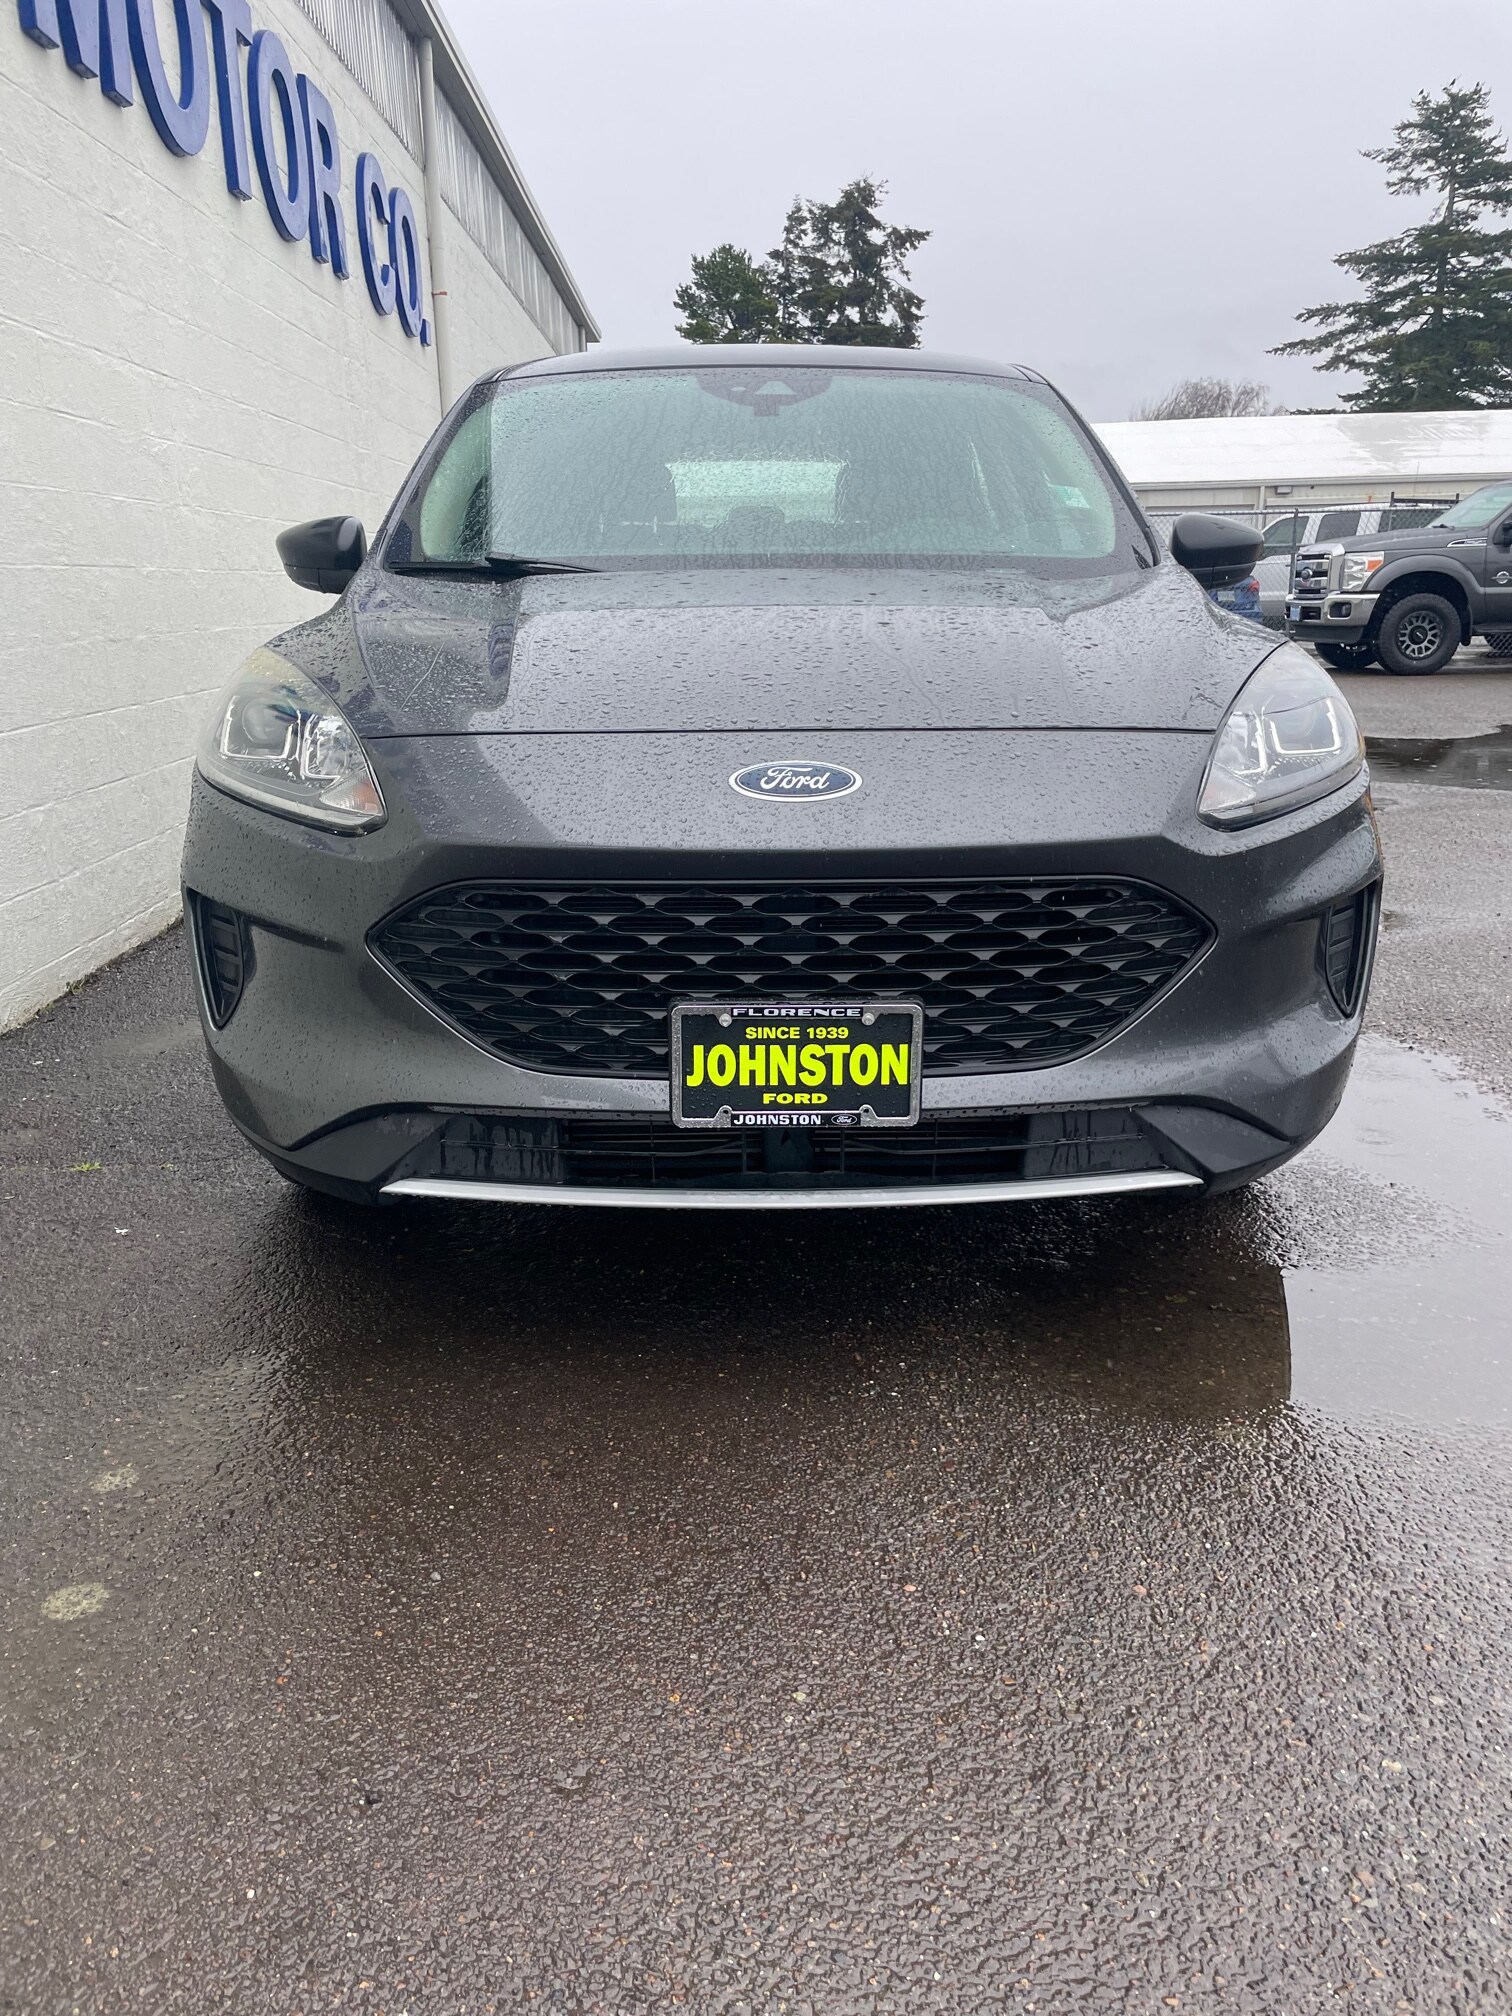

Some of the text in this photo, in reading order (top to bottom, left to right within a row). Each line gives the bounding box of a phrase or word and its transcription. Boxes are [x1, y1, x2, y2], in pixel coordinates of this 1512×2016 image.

[355, 152, 431, 347] CO.
[760, 766, 831, 790] Ford
[732, 1007, 862, 1017] FLORENCE
[745, 1026, 849, 1040] SINCE 1939
[686, 1043, 909, 1087] JOHNSTON
[762, 1092, 828, 1105] FORD
[733, 1114, 822, 1125] JOHNSTON
